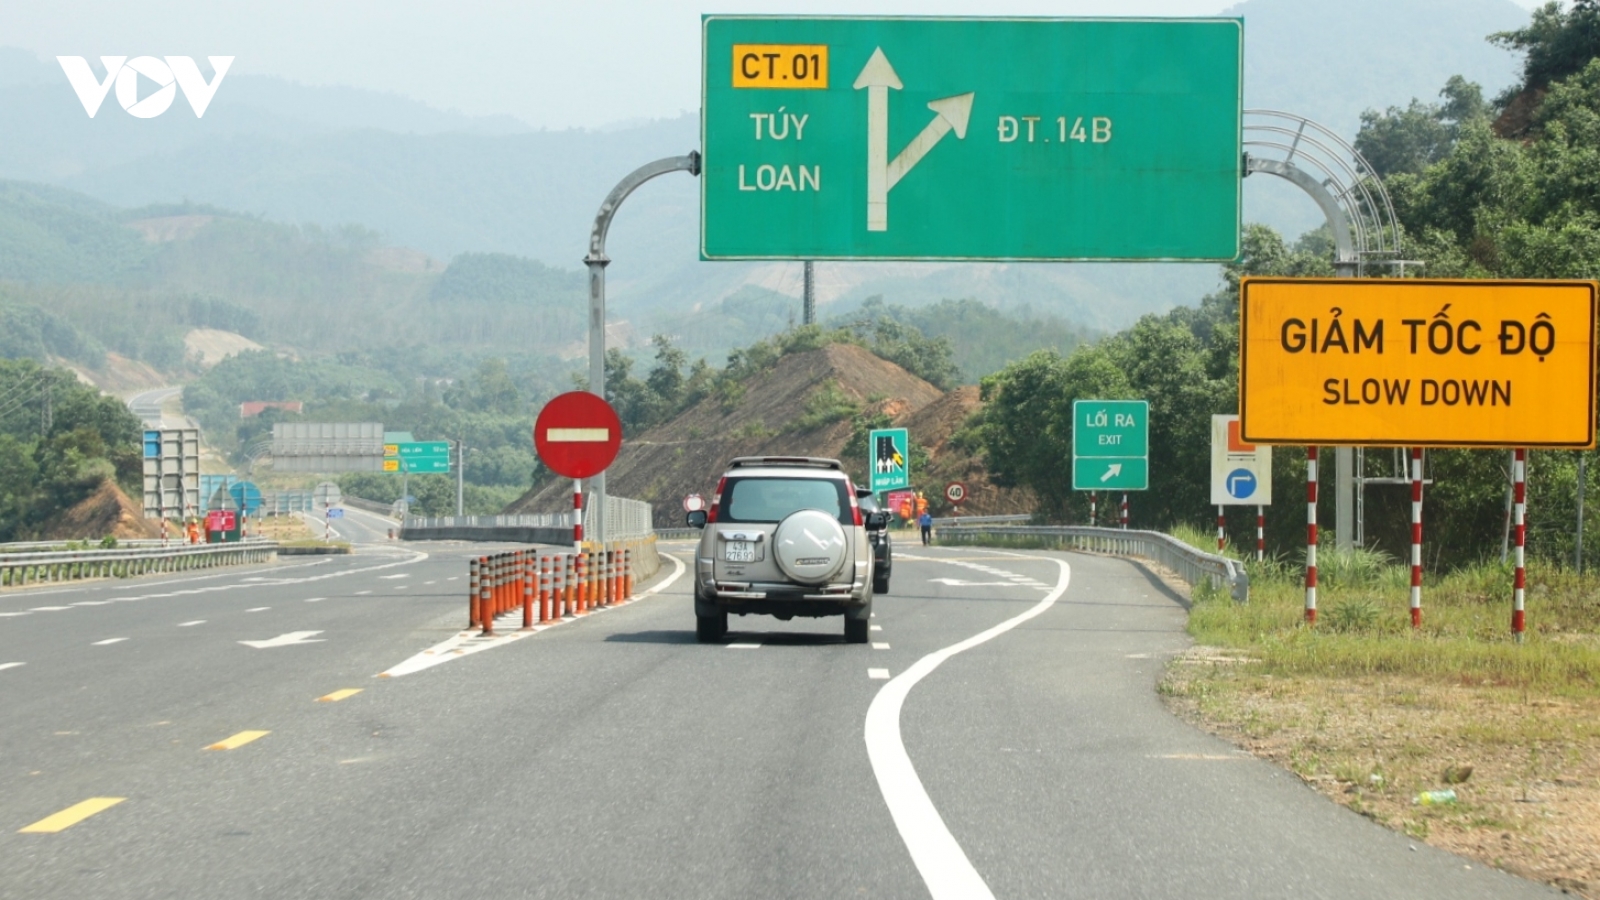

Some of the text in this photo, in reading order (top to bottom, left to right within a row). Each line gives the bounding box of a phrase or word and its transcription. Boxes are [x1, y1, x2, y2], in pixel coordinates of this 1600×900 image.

[741, 53, 820, 80] CT.01
[749, 106, 809, 141] TÚY
[739, 164, 821, 192] LOAN
[1281, 303, 1556, 363] GIẢM TỐC ĐỘ
[1322, 378, 1511, 406] SLOW DOWN
[1086, 409, 1135, 427] LỐI RA
[1098, 434, 1122, 445] EXIT
[949, 487, 962, 497] 40
[733, 541, 748, 551] 43A
